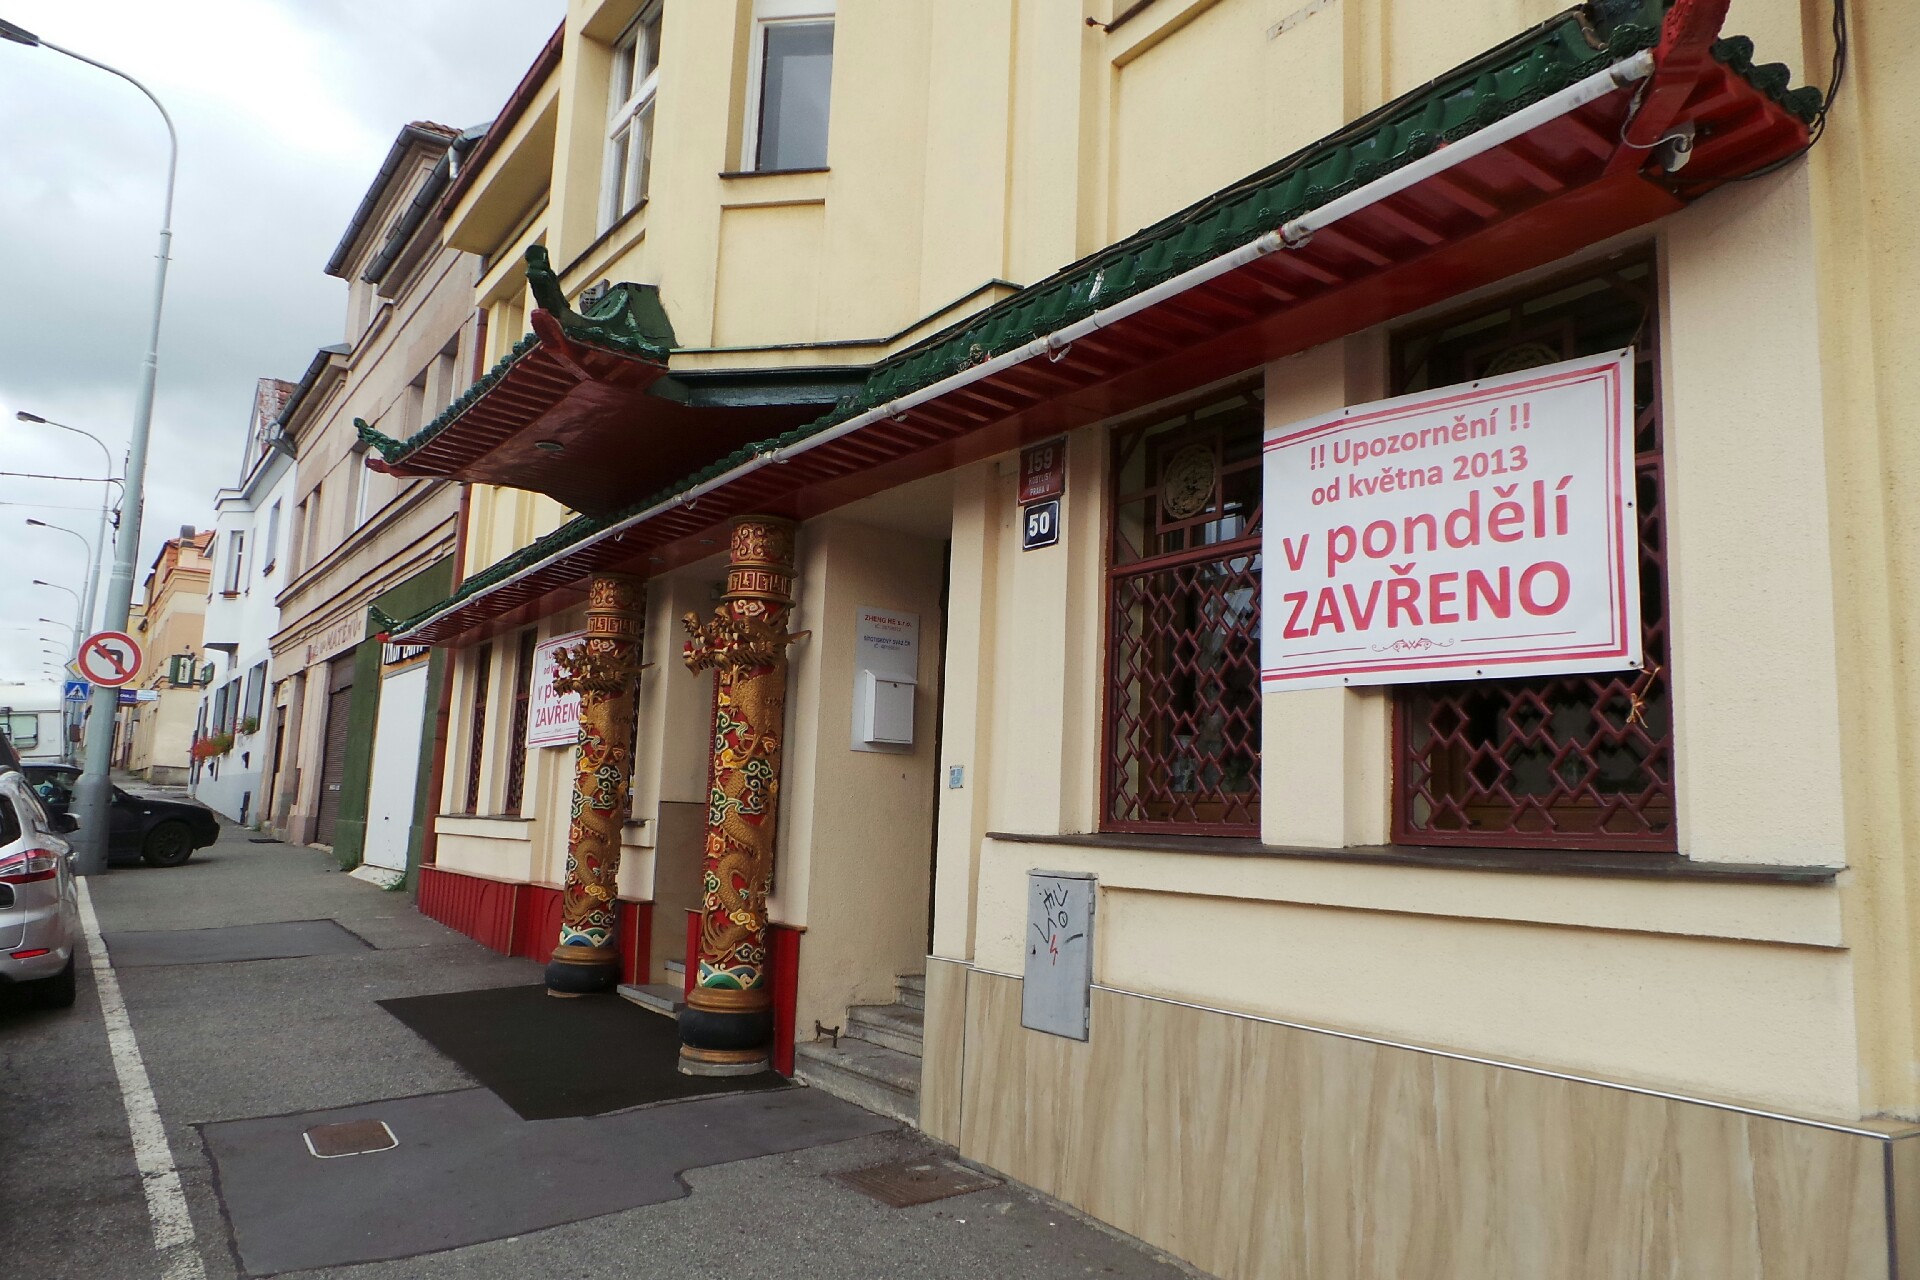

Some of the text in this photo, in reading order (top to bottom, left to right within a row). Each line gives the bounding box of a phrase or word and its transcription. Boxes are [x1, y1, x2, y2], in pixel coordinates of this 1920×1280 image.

[1310, 403, 1531, 470] !! Upozornění !!
[1028, 447, 1053, 475] 159
[1312, 445, 1529, 506] od května 2013
[1030, 486, 1045, 496] PRAHA
[1029, 511, 1050, 537] 50
[1282, 474, 1573, 578] v pondělí
[864, 615, 886, 624] ZHENG
[1282, 561, 1572, 640] ZAVŘENO
